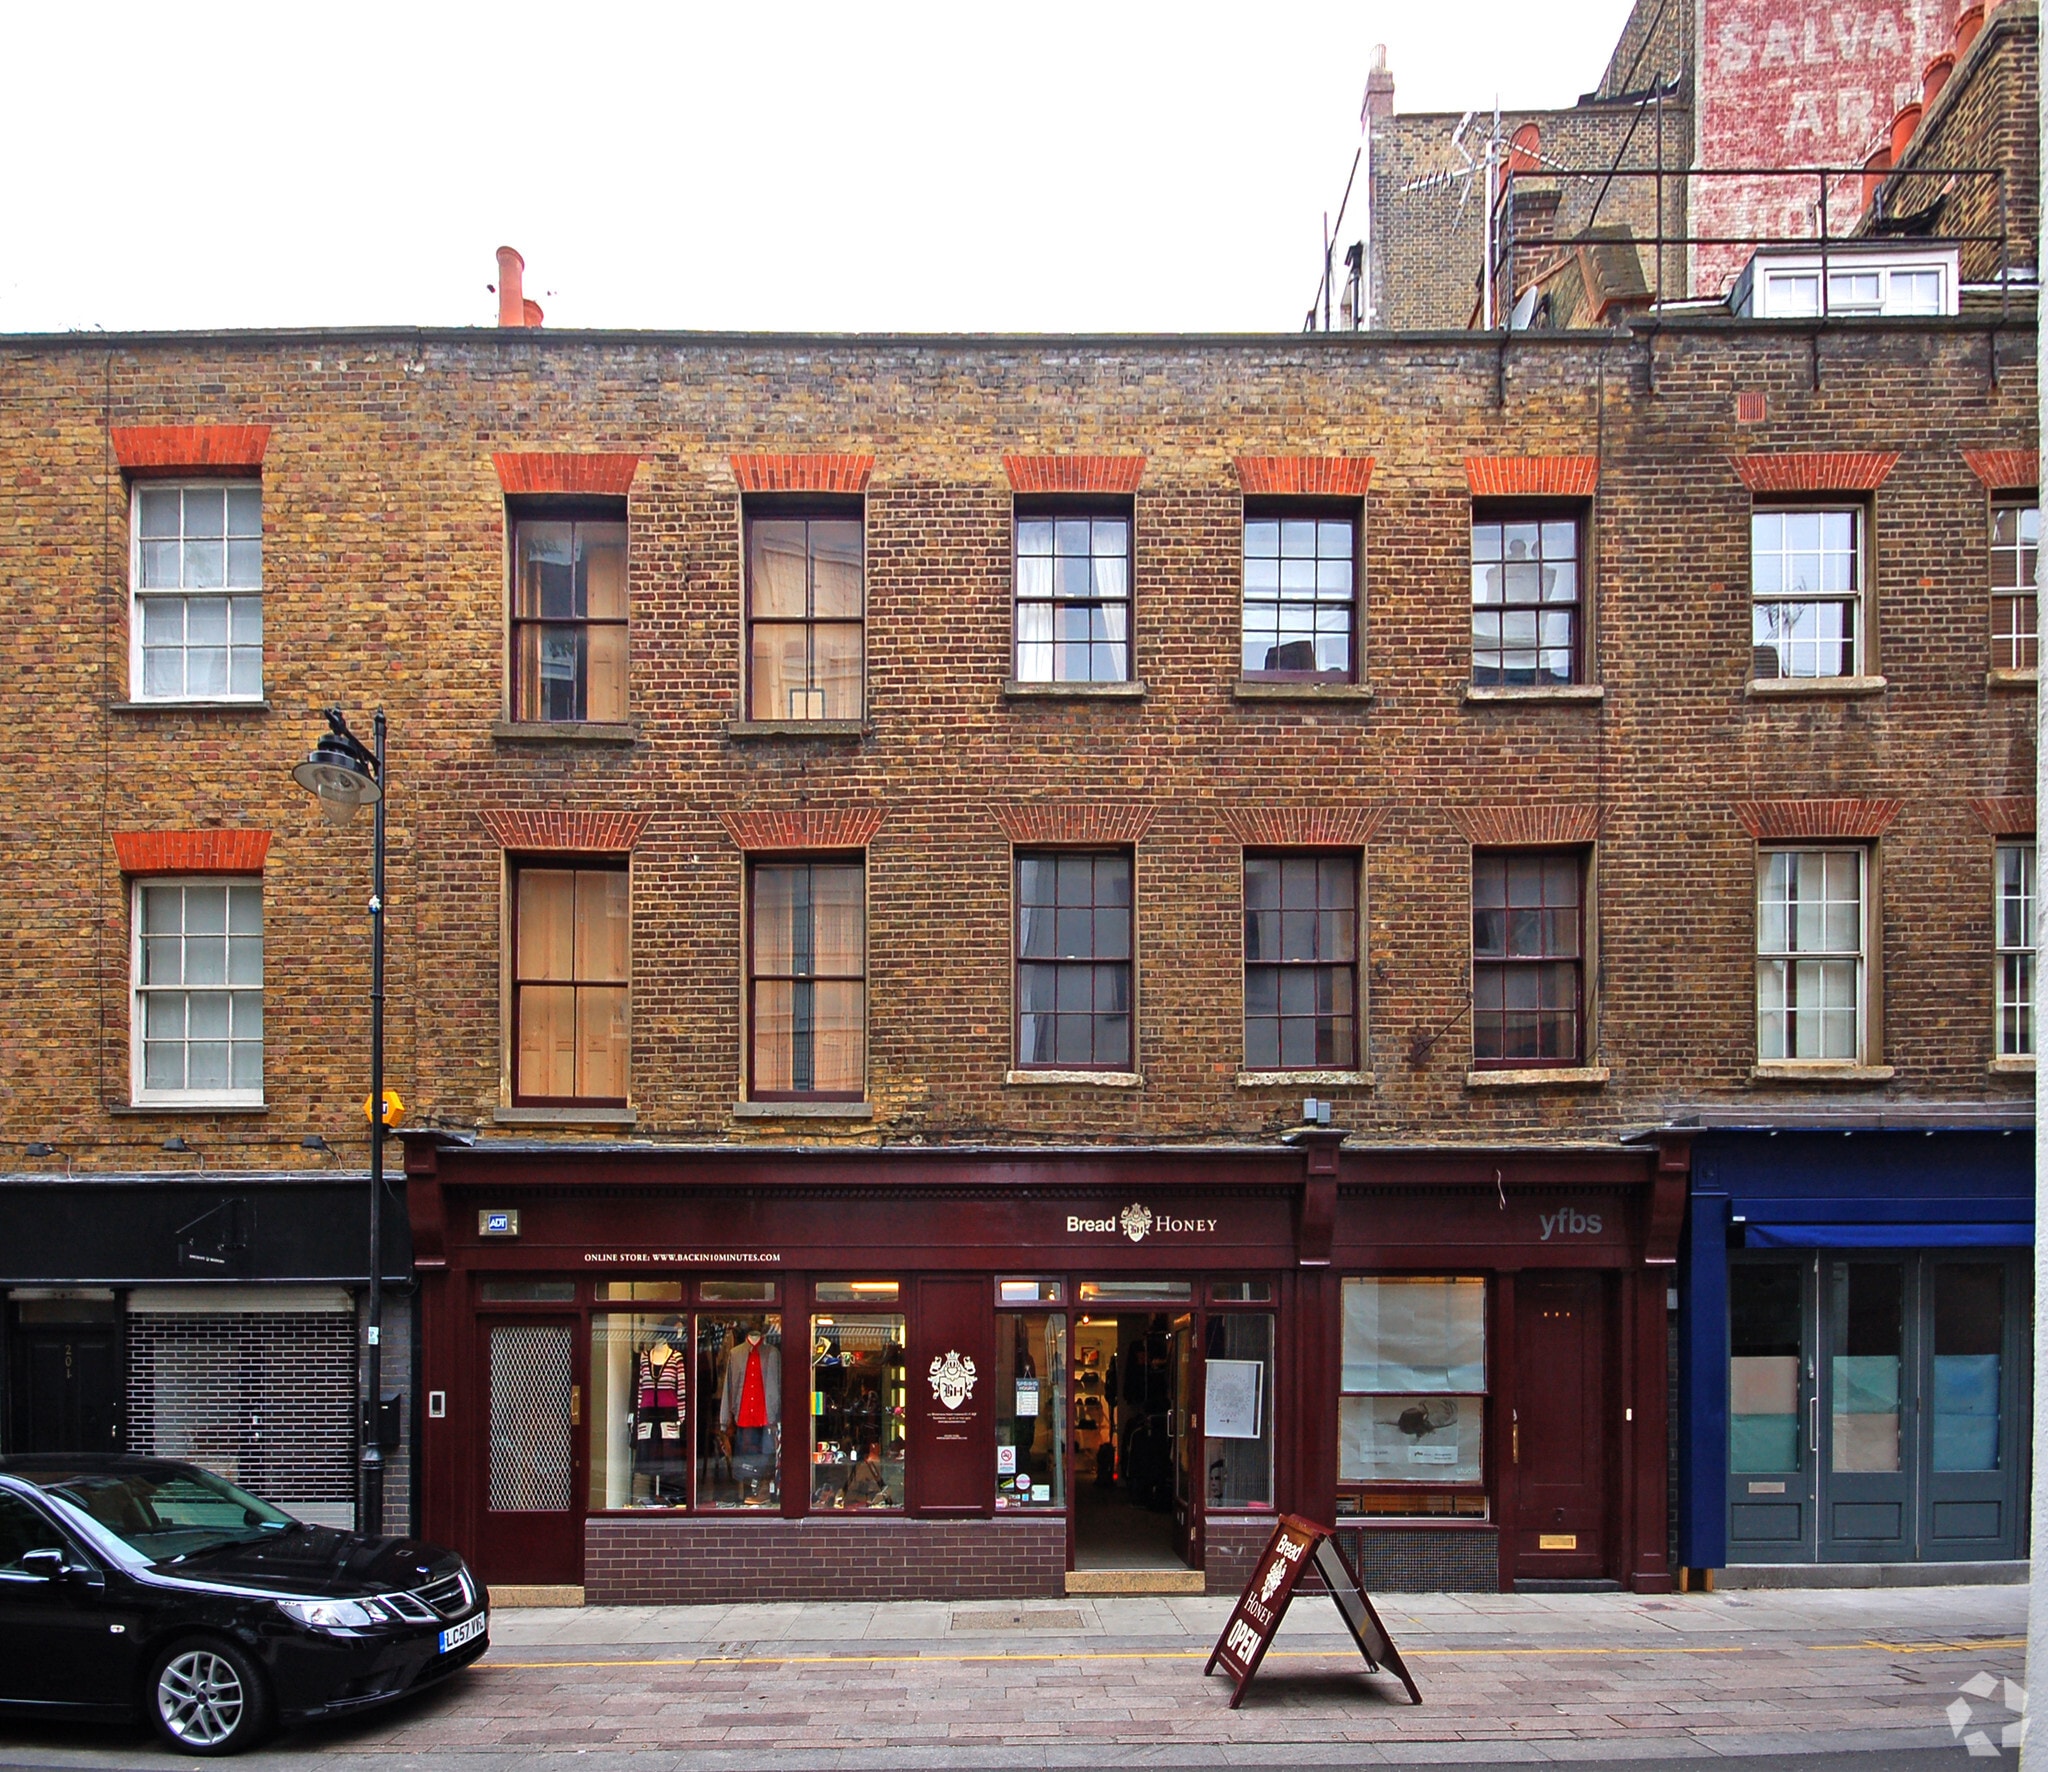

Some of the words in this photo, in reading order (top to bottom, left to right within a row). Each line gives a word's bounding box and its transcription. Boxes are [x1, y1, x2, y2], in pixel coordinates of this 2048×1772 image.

[1718, 3, 1946, 76] SALVAT
[489, 1218, 507, 1228] ADT
[1066, 1216, 1116, 1232] Bread
[1156, 1216, 1218, 1232] HONEY
[1540, 1207, 1603, 1241] yfbs
[584, 1253, 618, 1262] ONLINE
[619, 1253, 650, 1262] STORE:
[652, 1253, 781, 1262] WWW.BACKIN10MINUTES.COM
[1275, 1533, 1305, 1562] Bread
[1243, 1591, 1275, 1626] HONEY
[446, 1622, 470, 1647] LC57
[1226, 1618, 1262, 1665] OPEN
